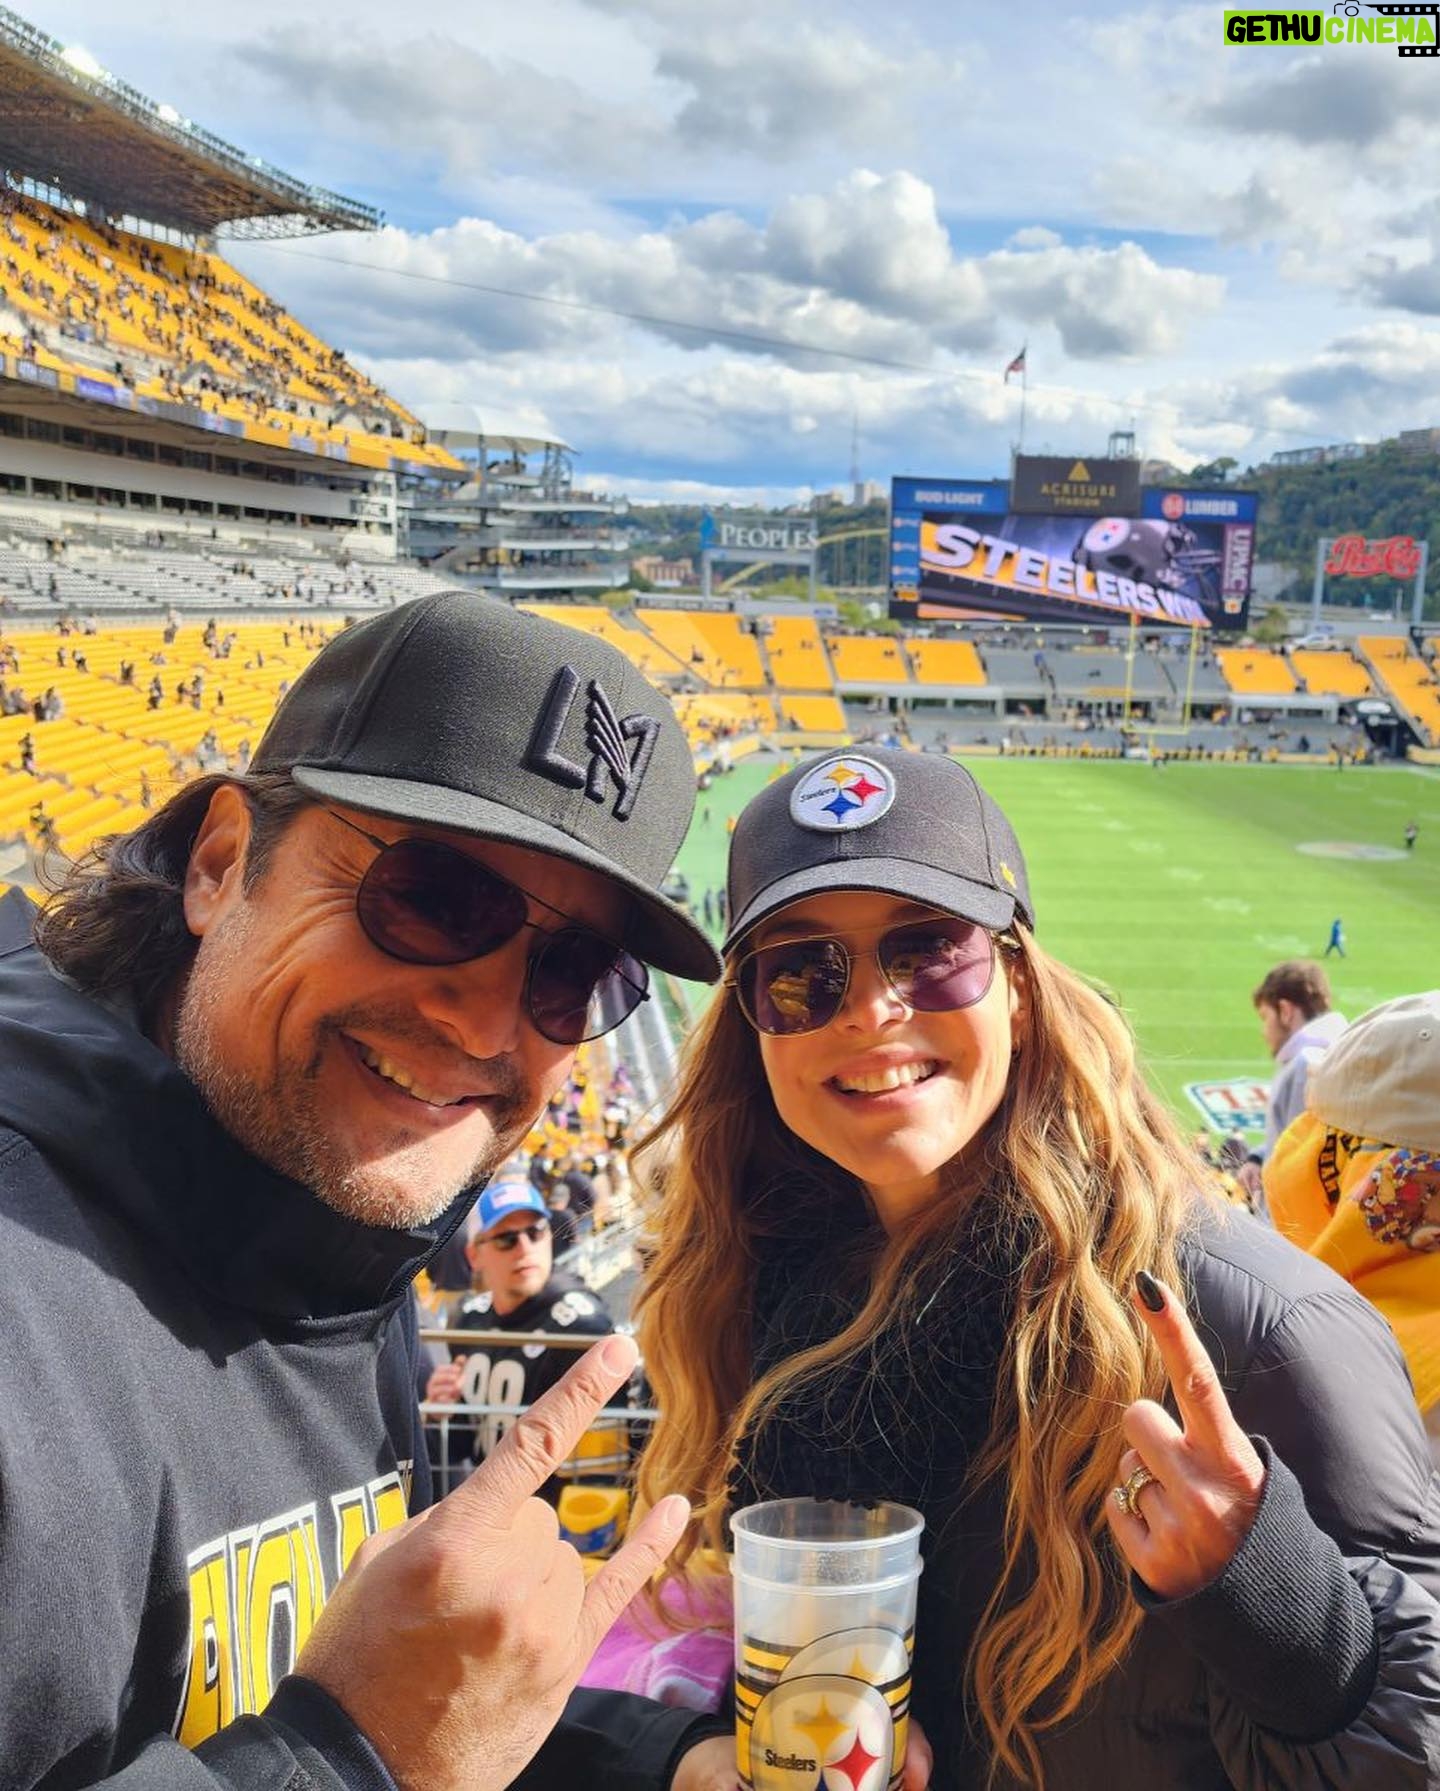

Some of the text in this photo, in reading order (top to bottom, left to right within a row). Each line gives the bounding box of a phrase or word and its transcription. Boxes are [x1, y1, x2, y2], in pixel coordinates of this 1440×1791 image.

[720, 522, 820, 551] PEOPLES
[919, 523, 1158, 613] STEELERS
[764, 1748, 817, 1772] Steelers
